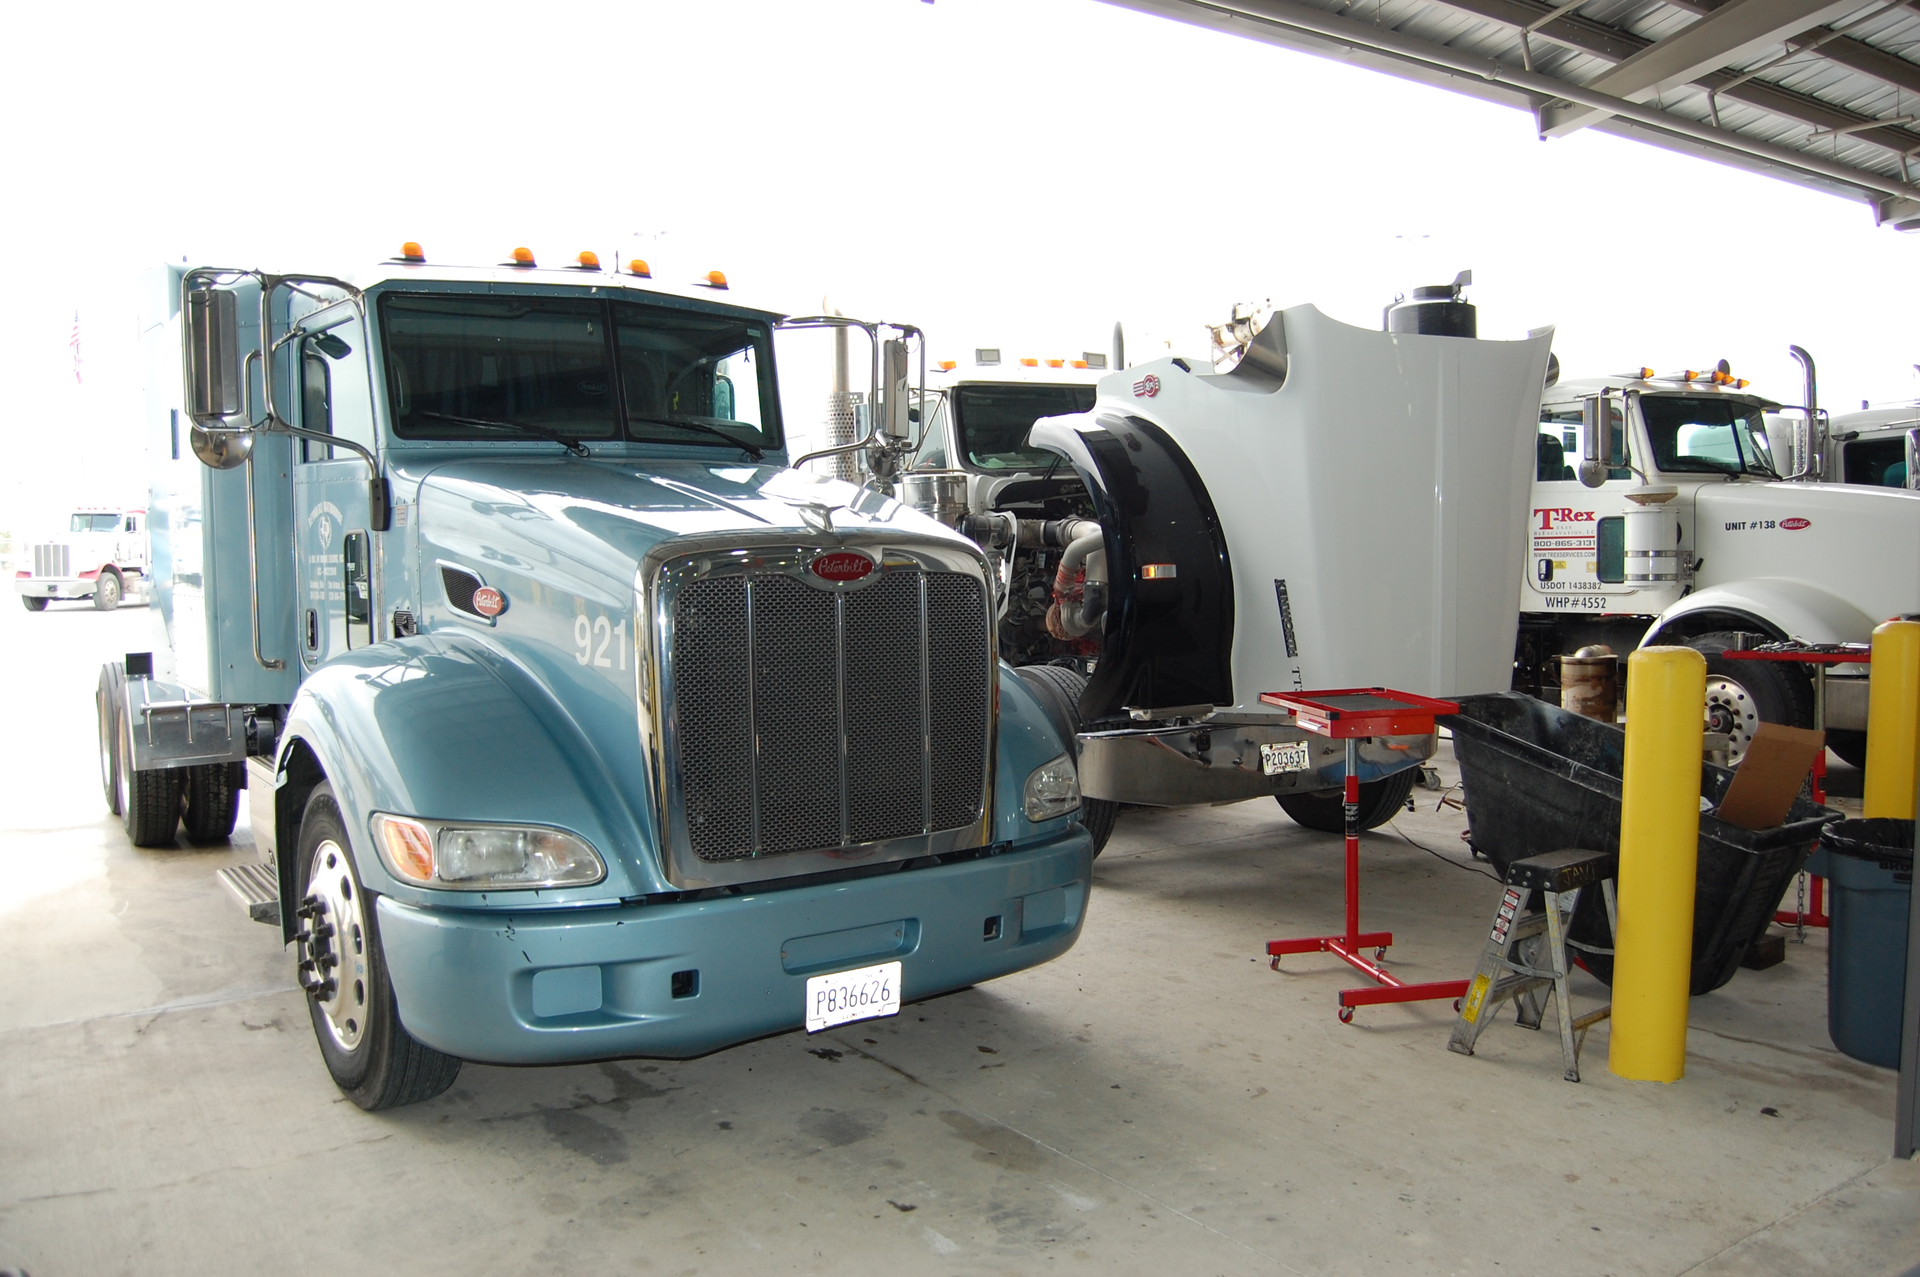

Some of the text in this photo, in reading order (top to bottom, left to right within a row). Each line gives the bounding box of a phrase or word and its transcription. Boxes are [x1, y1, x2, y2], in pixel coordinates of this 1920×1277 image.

[1533, 507, 1596, 530] T-Rex
[1725, 520, 1776, 531] UNIT #138
[1781, 519, 1808, 528] Peterbilt
[819, 557, 868, 574] Peterbilt
[1540, 581, 1602, 590] USDOT 1438382
[476, 591, 500, 608] Peterbilt
[1545, 596, 1607, 609] WHP#4552
[1274, 579, 1298, 658] KENWORTH
[574, 614, 626, 671] 921
[1265, 749, 1306, 767] P203637
[816, 977, 890, 1016] P836626
